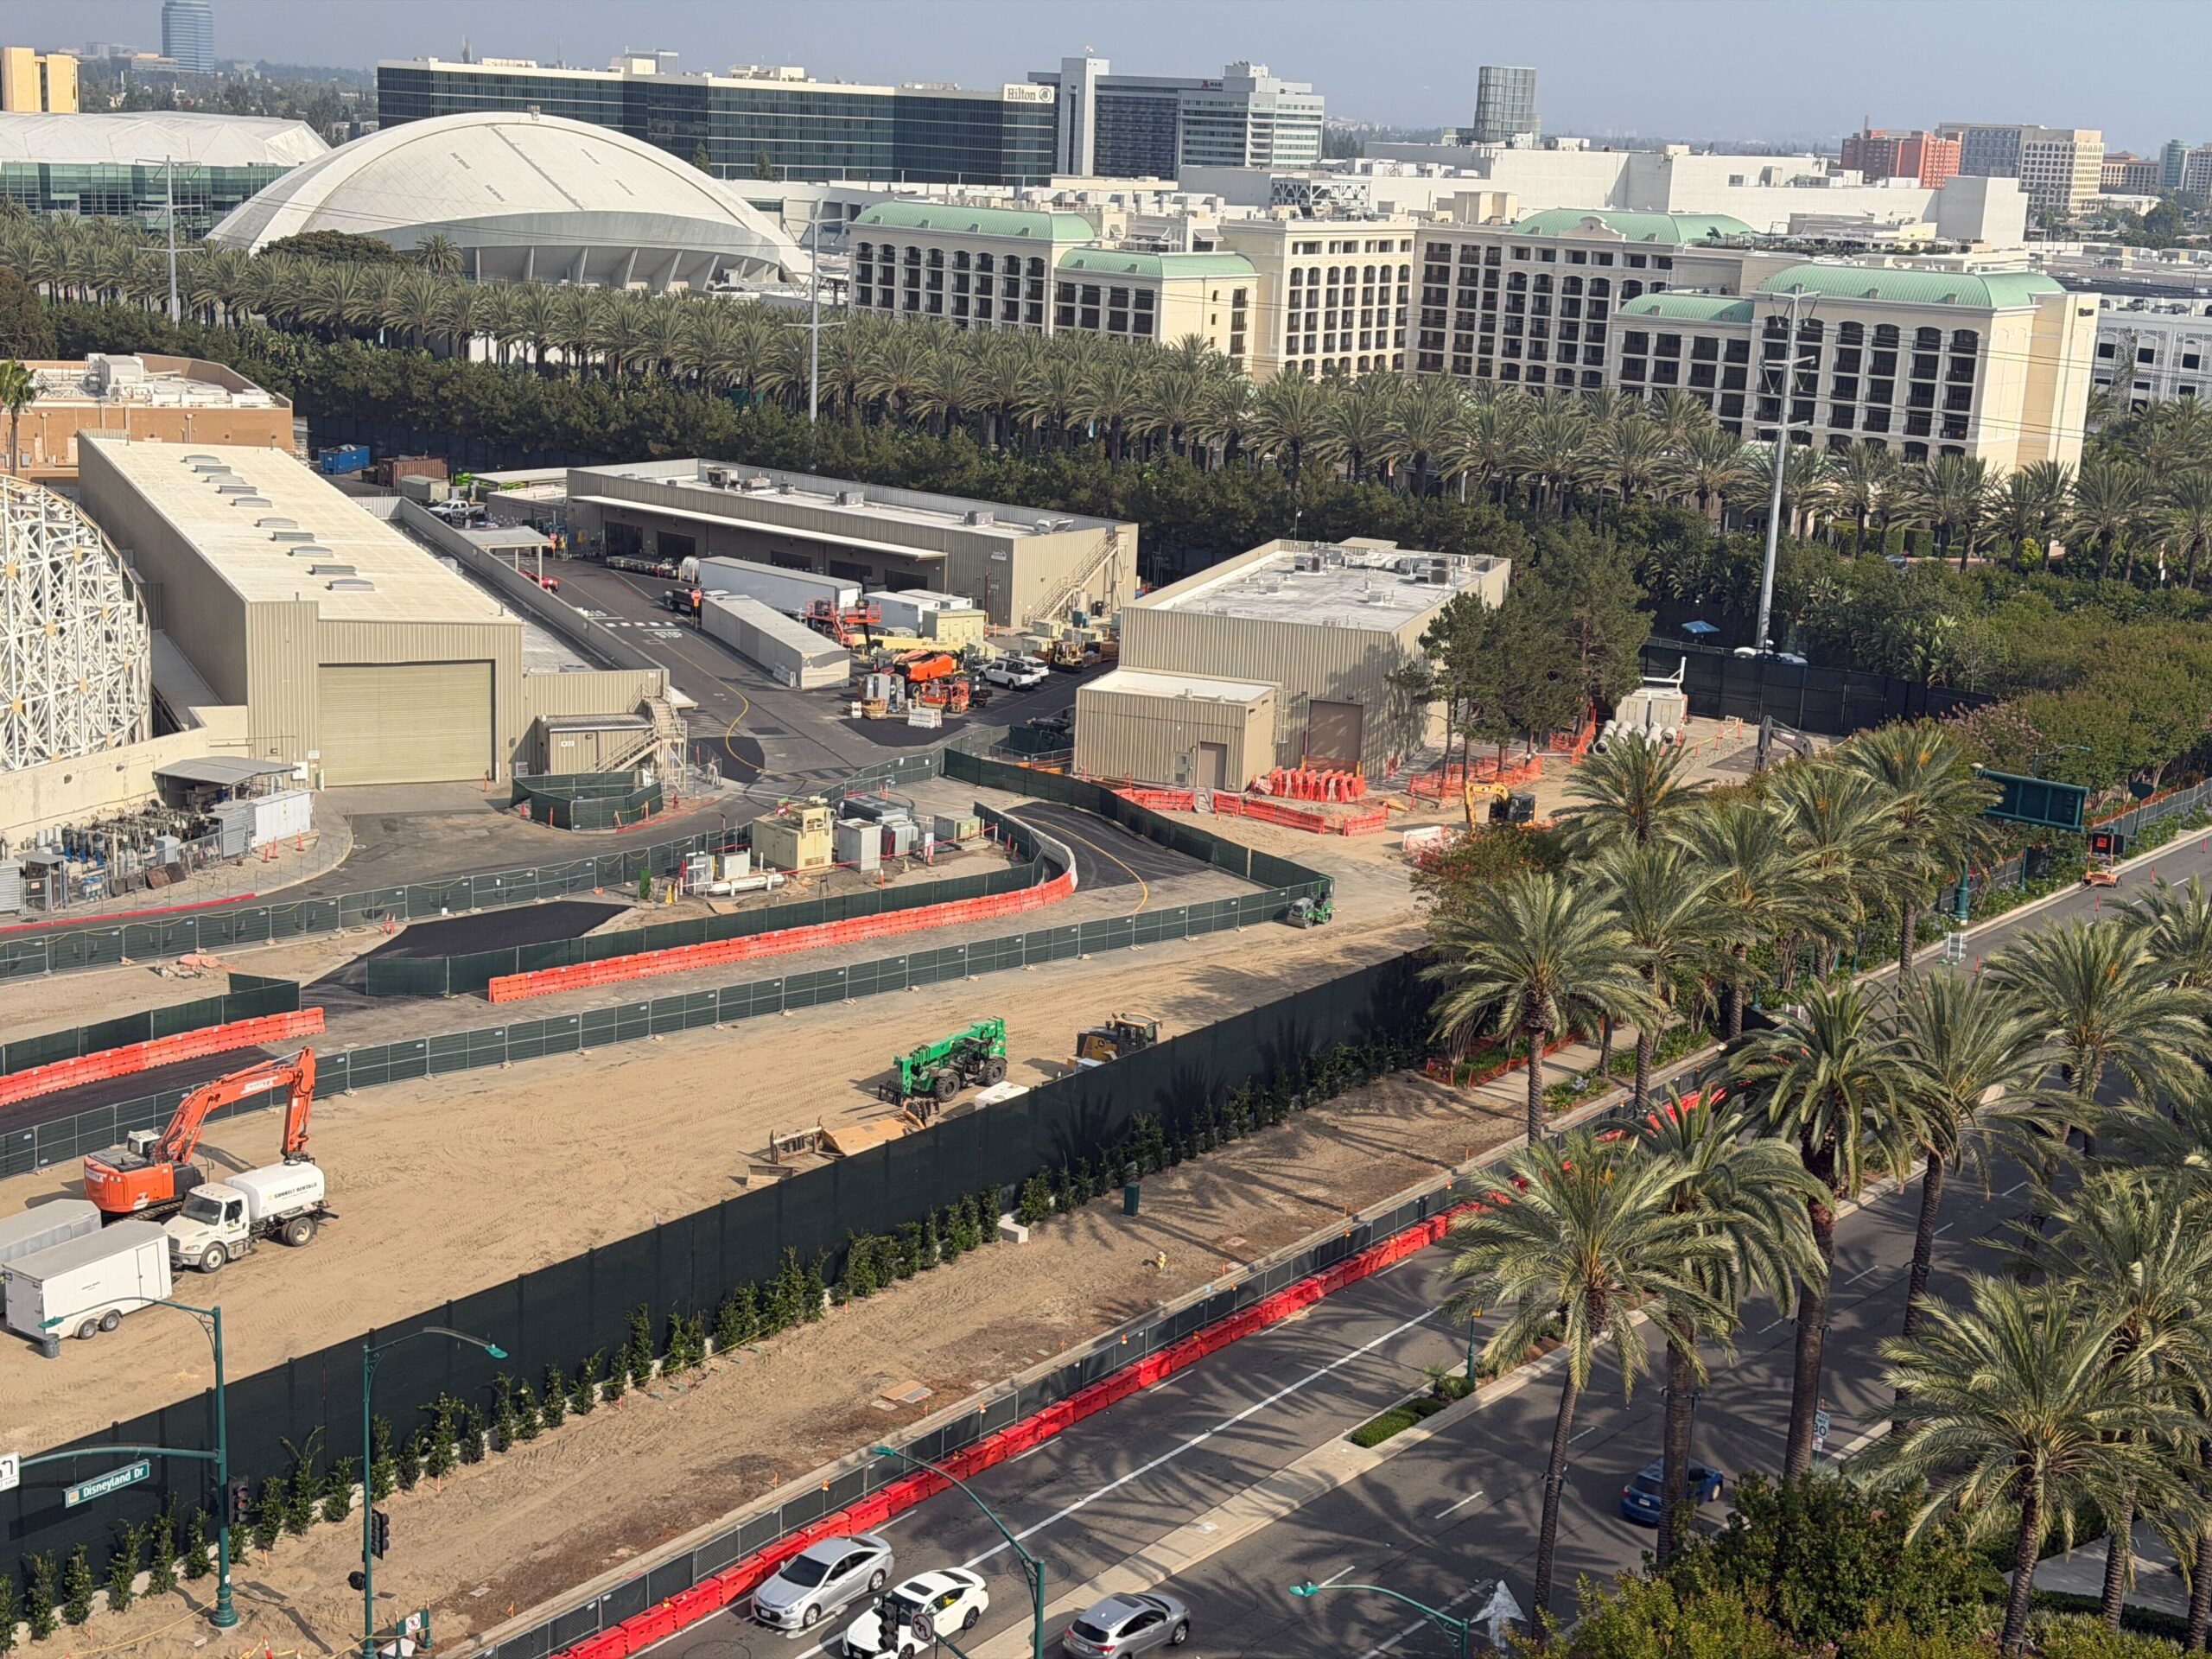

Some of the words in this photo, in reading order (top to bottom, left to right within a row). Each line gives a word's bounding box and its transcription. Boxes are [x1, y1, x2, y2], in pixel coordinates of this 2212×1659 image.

[1007, 87, 1036, 100] Hilton
[274, 1188, 296, 1199] SUNBELT
[296, 1181, 318, 1192] RENTALS
[1814, 1422, 1827, 1436] 30
[83, 1470, 131, 1497] Disneyland
[134, 1467, 144, 1479] Dr
